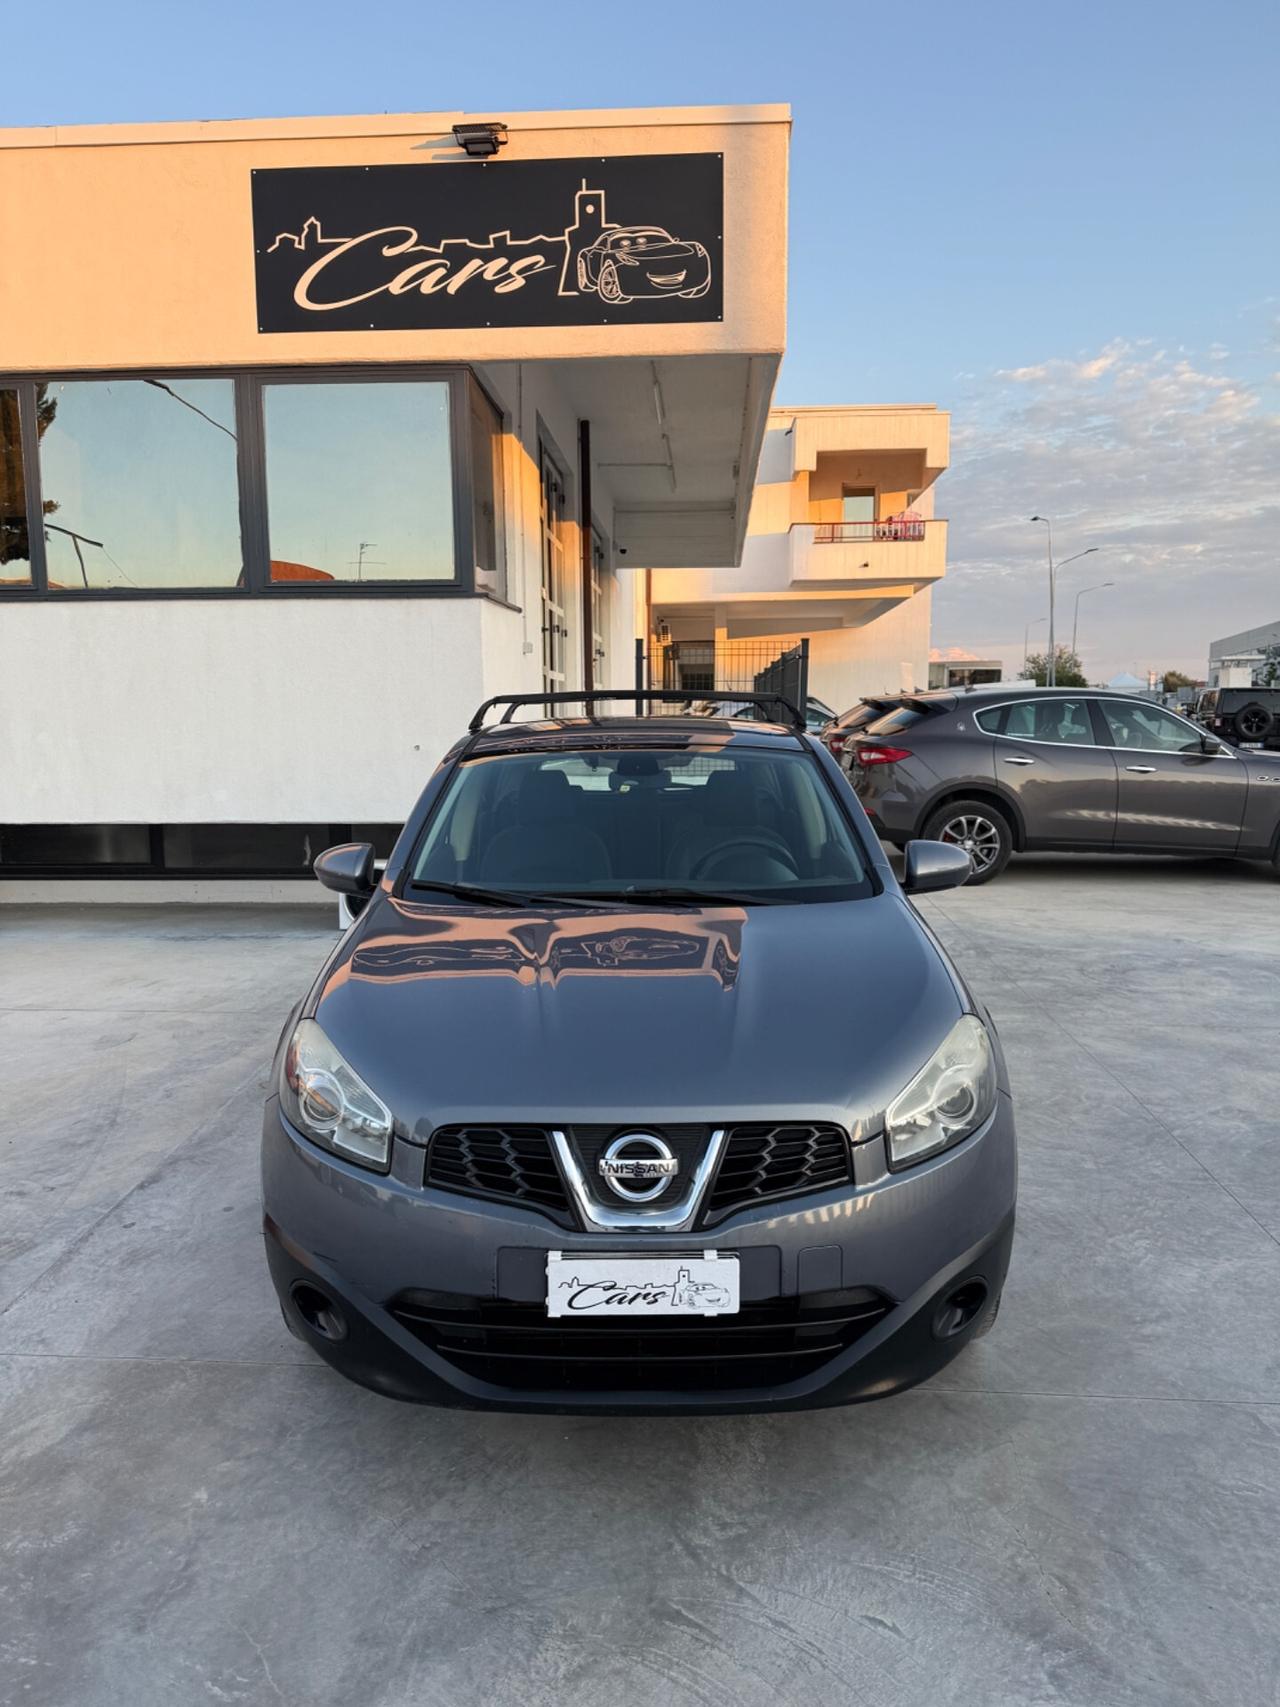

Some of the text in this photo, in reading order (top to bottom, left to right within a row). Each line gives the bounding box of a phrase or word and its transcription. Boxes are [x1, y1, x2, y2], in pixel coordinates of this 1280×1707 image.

[294, 226, 556, 311] Cars
[606, 1162, 670, 1174] NISSAN
[567, 1280, 669, 1310] Cars
